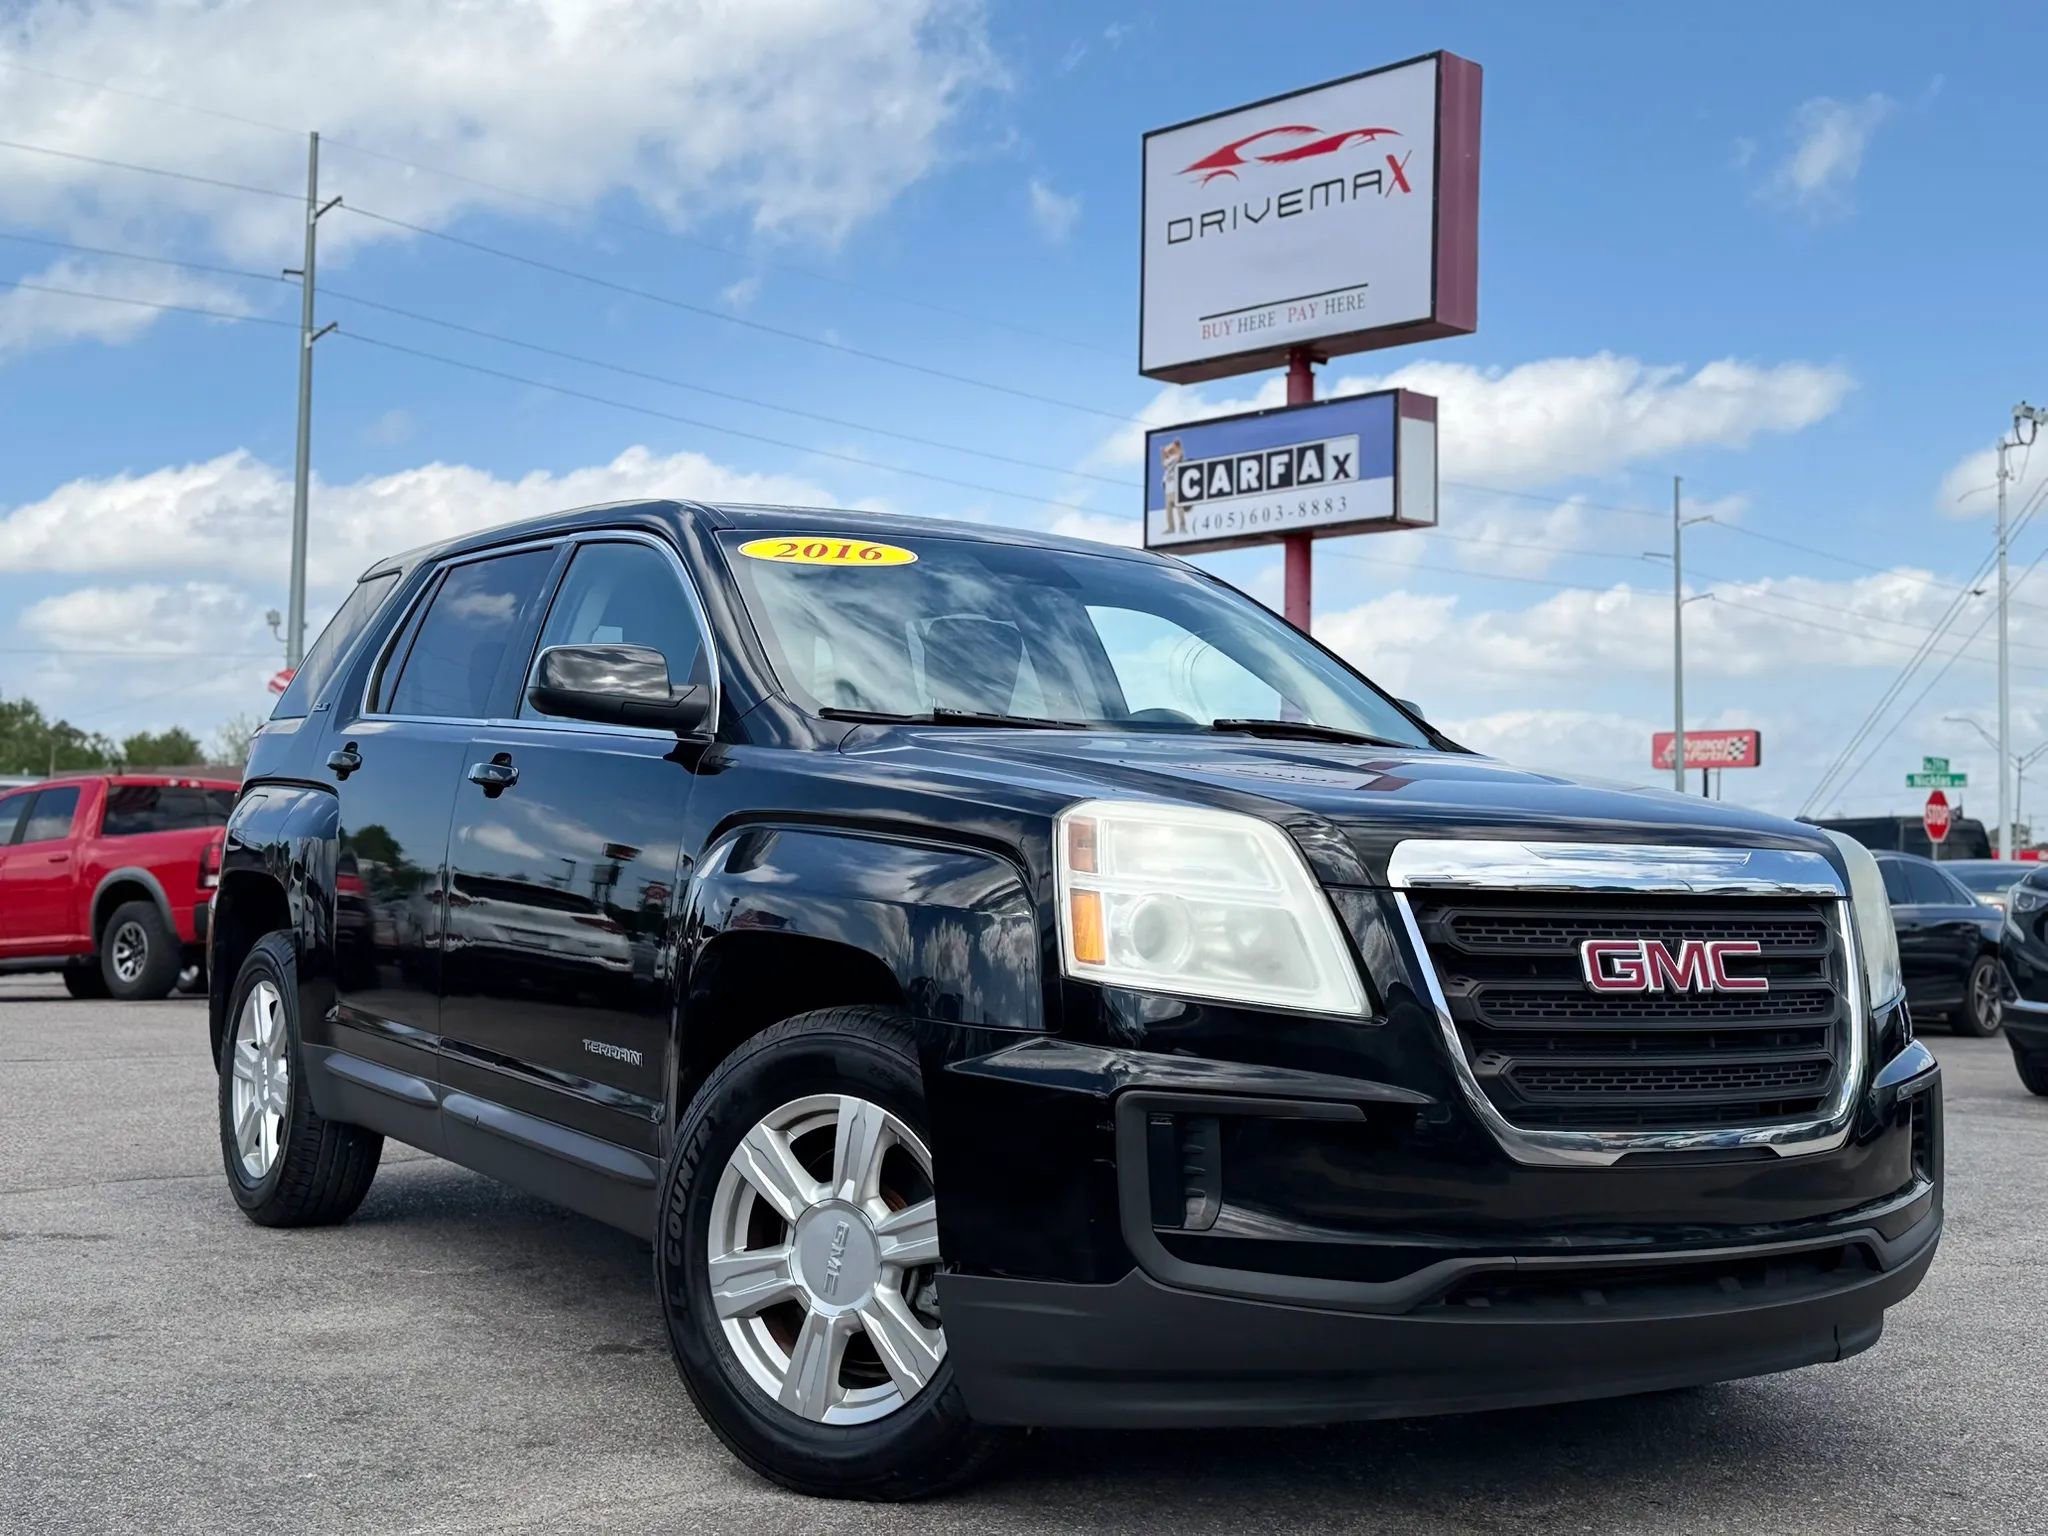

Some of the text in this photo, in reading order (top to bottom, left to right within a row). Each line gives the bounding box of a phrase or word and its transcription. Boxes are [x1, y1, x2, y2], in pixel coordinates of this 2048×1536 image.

[1201, 292, 1367, 341] BUY HERE PAY HERE
[1179, 448, 1353, 500] CARFAX
[1191, 495, 1348, 534] (405)603-8883
[773, 542, 883, 561] 2016
[1926, 803, 1950, 826] STOP
[1580, 938, 1770, 994] GMC
[582, 1038, 643, 1067] TERRAIN
[823, 1220, 850, 1297] GMC
